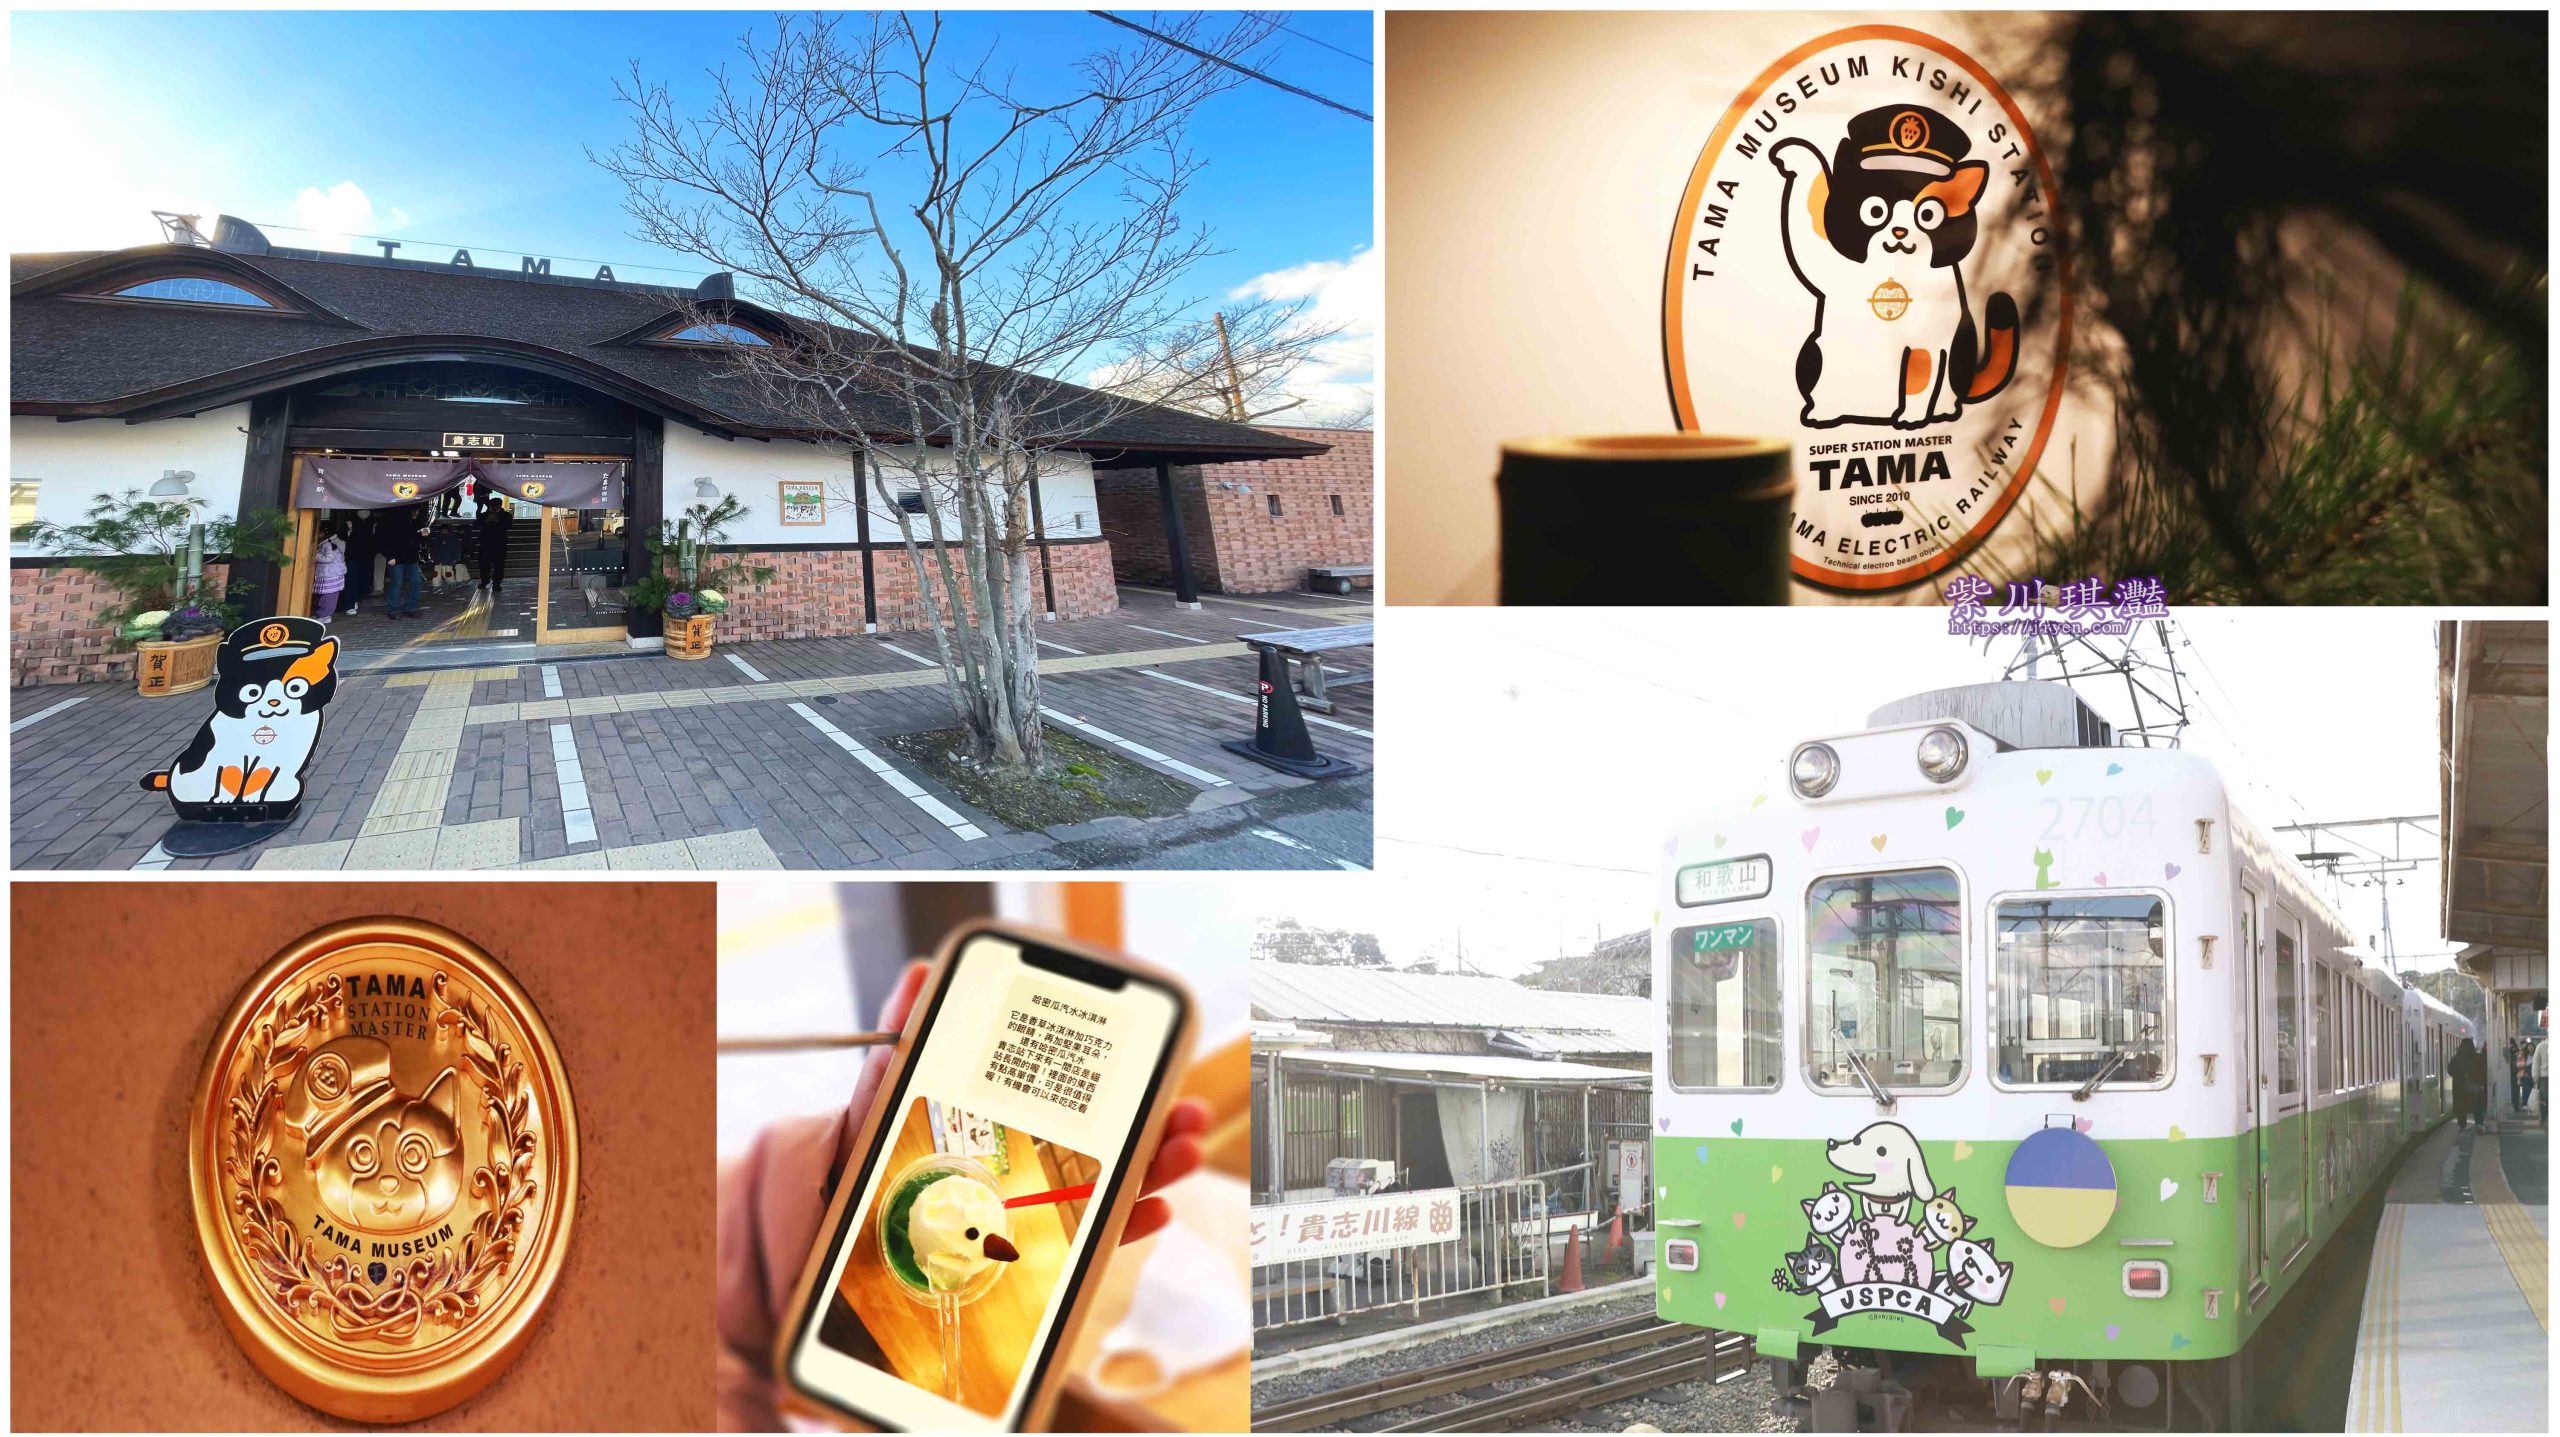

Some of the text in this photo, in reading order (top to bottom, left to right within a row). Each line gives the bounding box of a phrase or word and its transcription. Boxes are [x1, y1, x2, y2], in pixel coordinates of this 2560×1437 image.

[1692, 177, 1740, 281] TAMA
[1735, 55, 1869, 161] MUSEUM
[1891, 55, 1984, 116] KISHI
[377, 240, 616, 282] TAMA
[452, 435, 495, 447] 貴志駅
[1809, 435, 1953, 456] SUPER STATION MASTER
[1809, 451, 1952, 491] TAMA
[1837, 515, 1950, 556] ELECTRIC
[1956, 417, 2023, 514] RAILWAY
[1849, 491, 1910, 506] SINCE 2010
[1823, 556, 1860, 569] Technical
[1862, 560, 1895, 570] electron
[1897, 555, 1918, 565] beam
[690, 623, 703, 650] 賀正
[148, 653, 167, 688] 賀正
[1261, 695, 1268, 704] NO
[2039, 792, 2159, 840] 2704
[1695, 862, 1756, 890] 和歌山
[1695, 926, 1752, 949] ワンマン
[346, 974, 426, 1000] TAMA
[348, 1002, 430, 1022] STATION
[1031, 994, 1107, 1026] 哈密瓜汽水冰淇淋
[350, 1021, 427, 1040] MASTER
[1010, 1010, 1113, 1051] 它是香草冰淇淋加巧克力
[312, 1214, 454, 1258] TAMA MUSEUM
[1840, 1287, 1932, 1316] JSPCA
